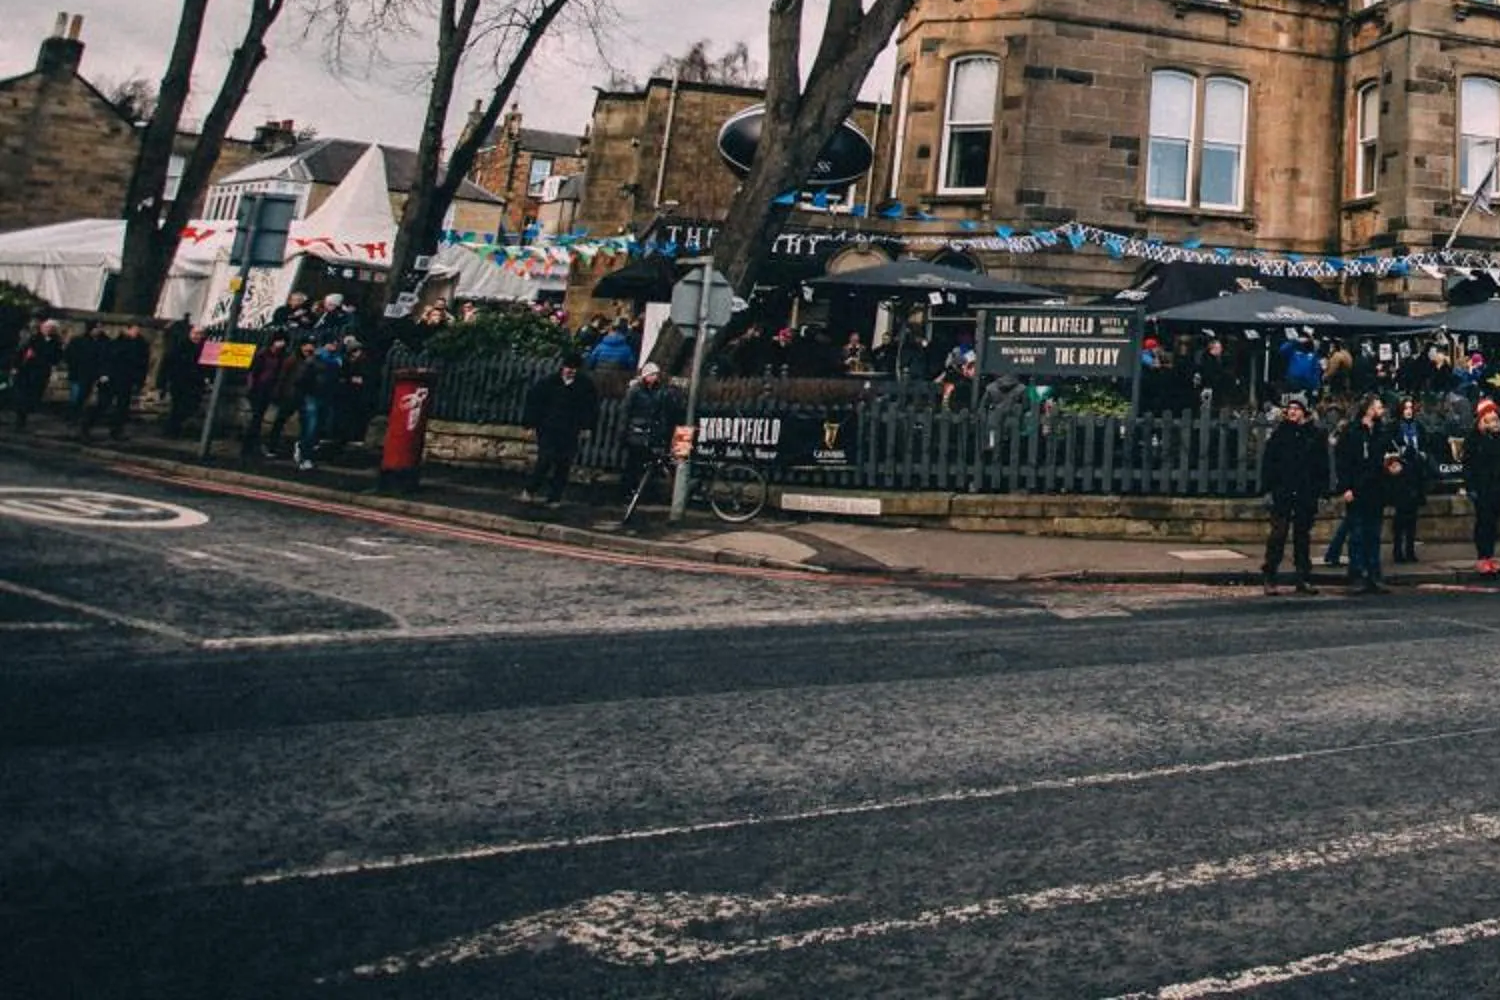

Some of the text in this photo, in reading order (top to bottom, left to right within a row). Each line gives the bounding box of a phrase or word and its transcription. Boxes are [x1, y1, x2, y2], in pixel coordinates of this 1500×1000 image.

[995, 315, 1015, 333] THE
[1019, 315, 1095, 335] MURRAYFIELD
[1055, 347, 1121, 367] THE BOTHY
